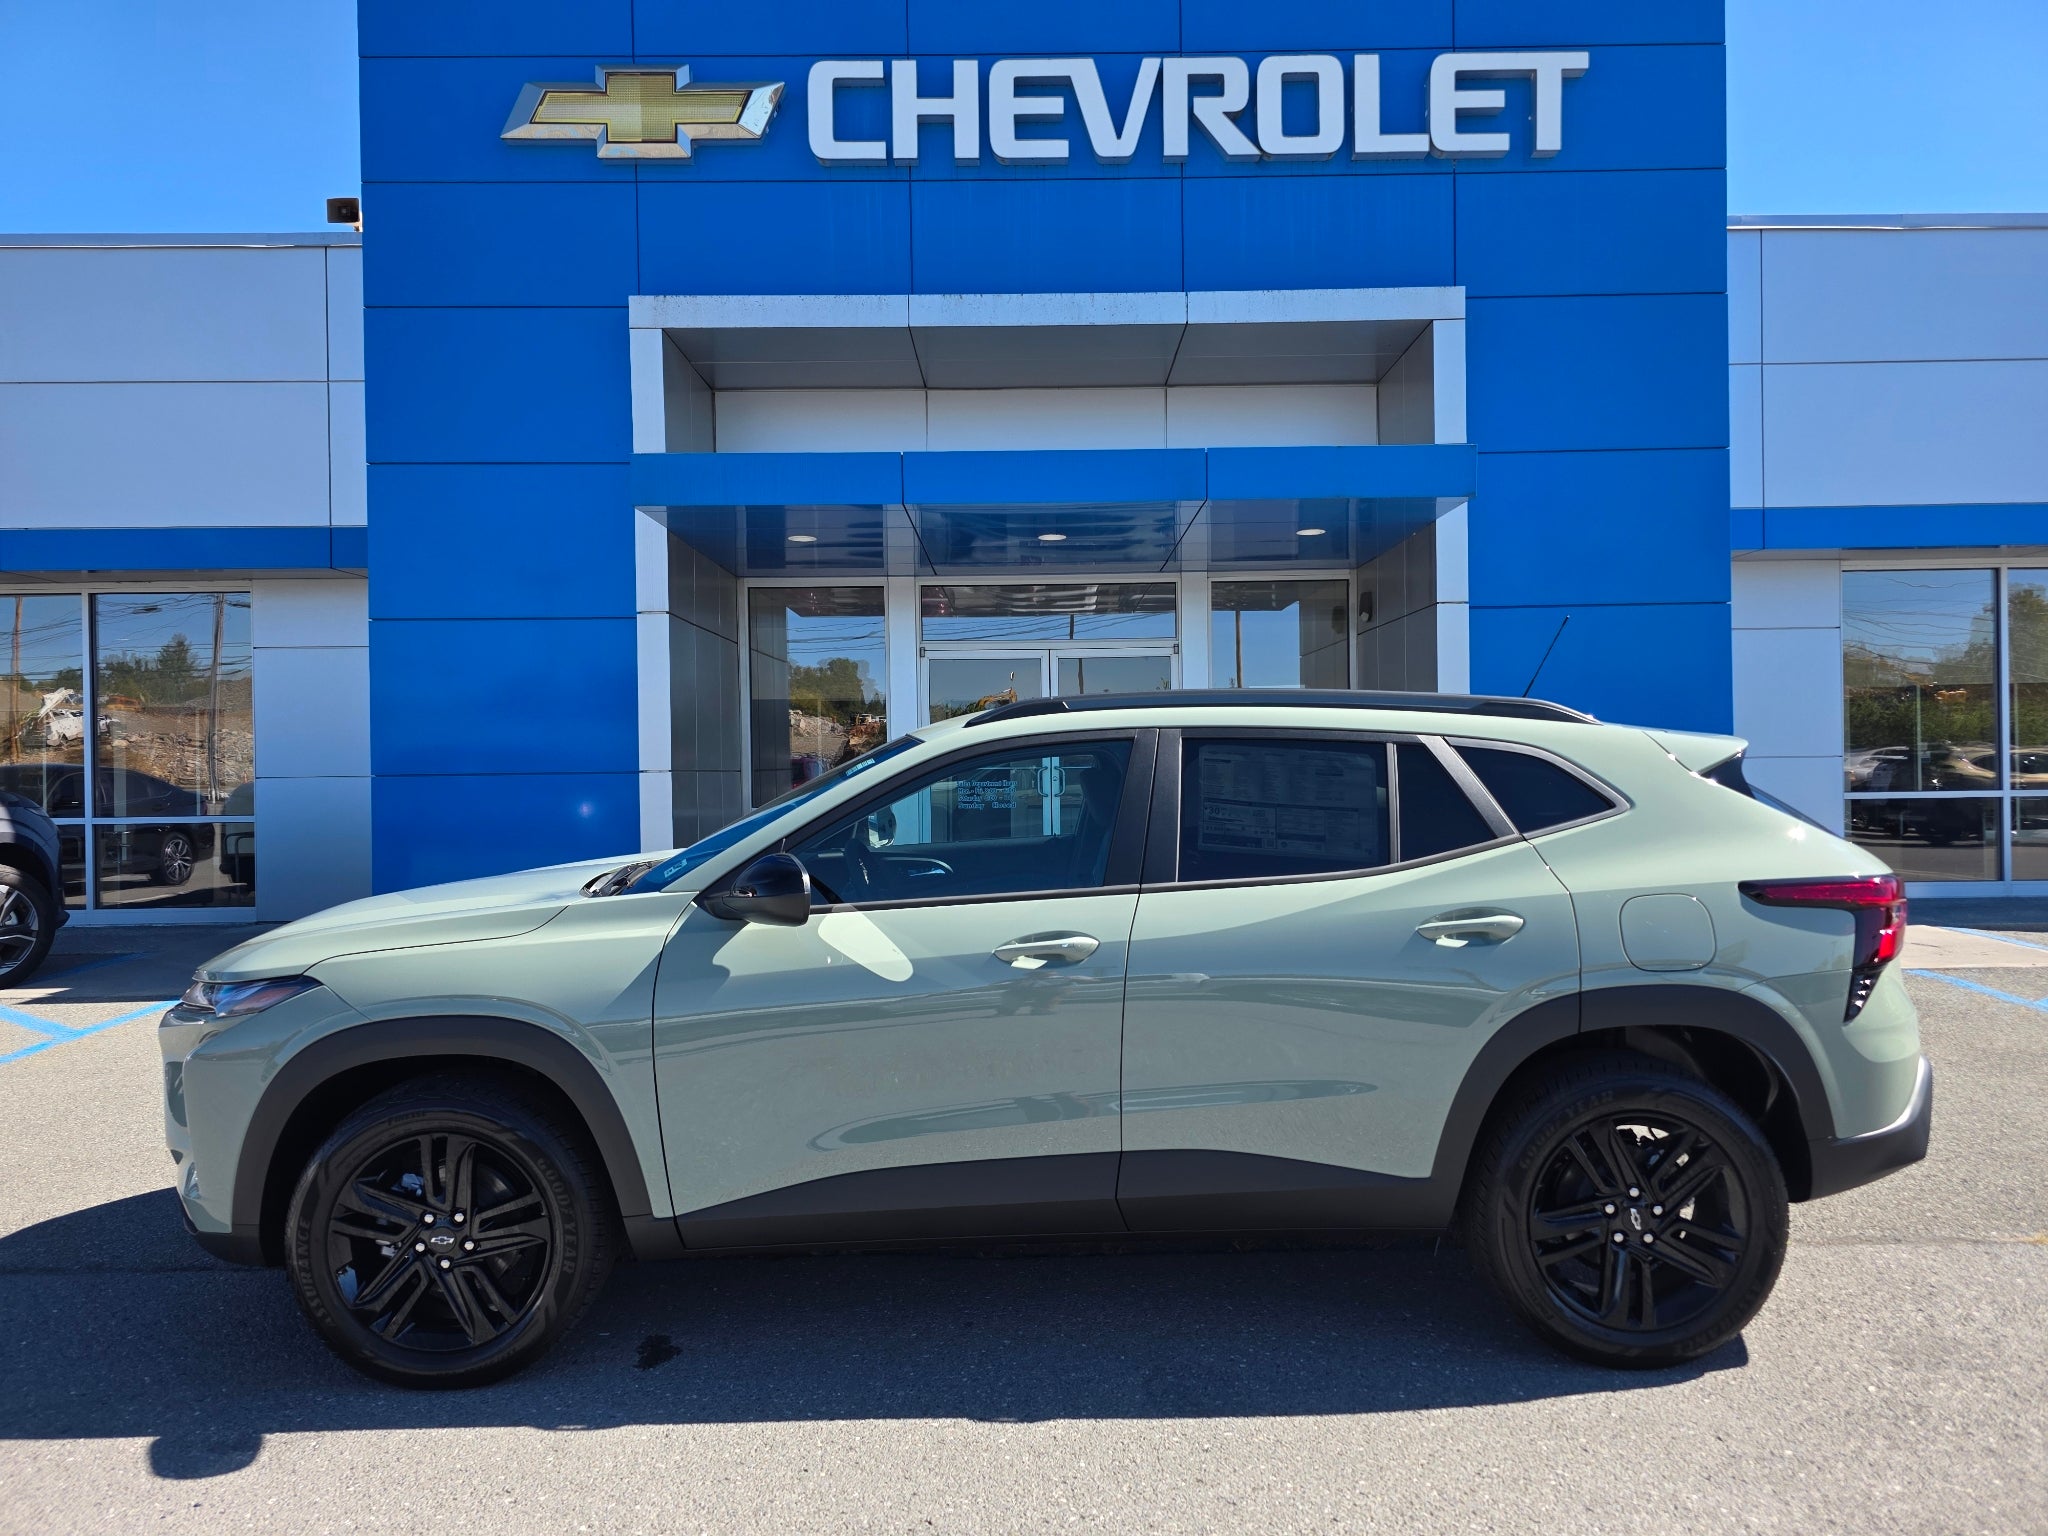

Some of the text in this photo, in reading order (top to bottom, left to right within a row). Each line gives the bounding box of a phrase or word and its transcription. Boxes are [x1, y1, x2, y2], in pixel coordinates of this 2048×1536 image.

[807, 51, 1591, 166] CHEVROLET
[296, 1217, 337, 1327] ASSURANCE
[536, 1157, 577, 1275] GOODYEAR
